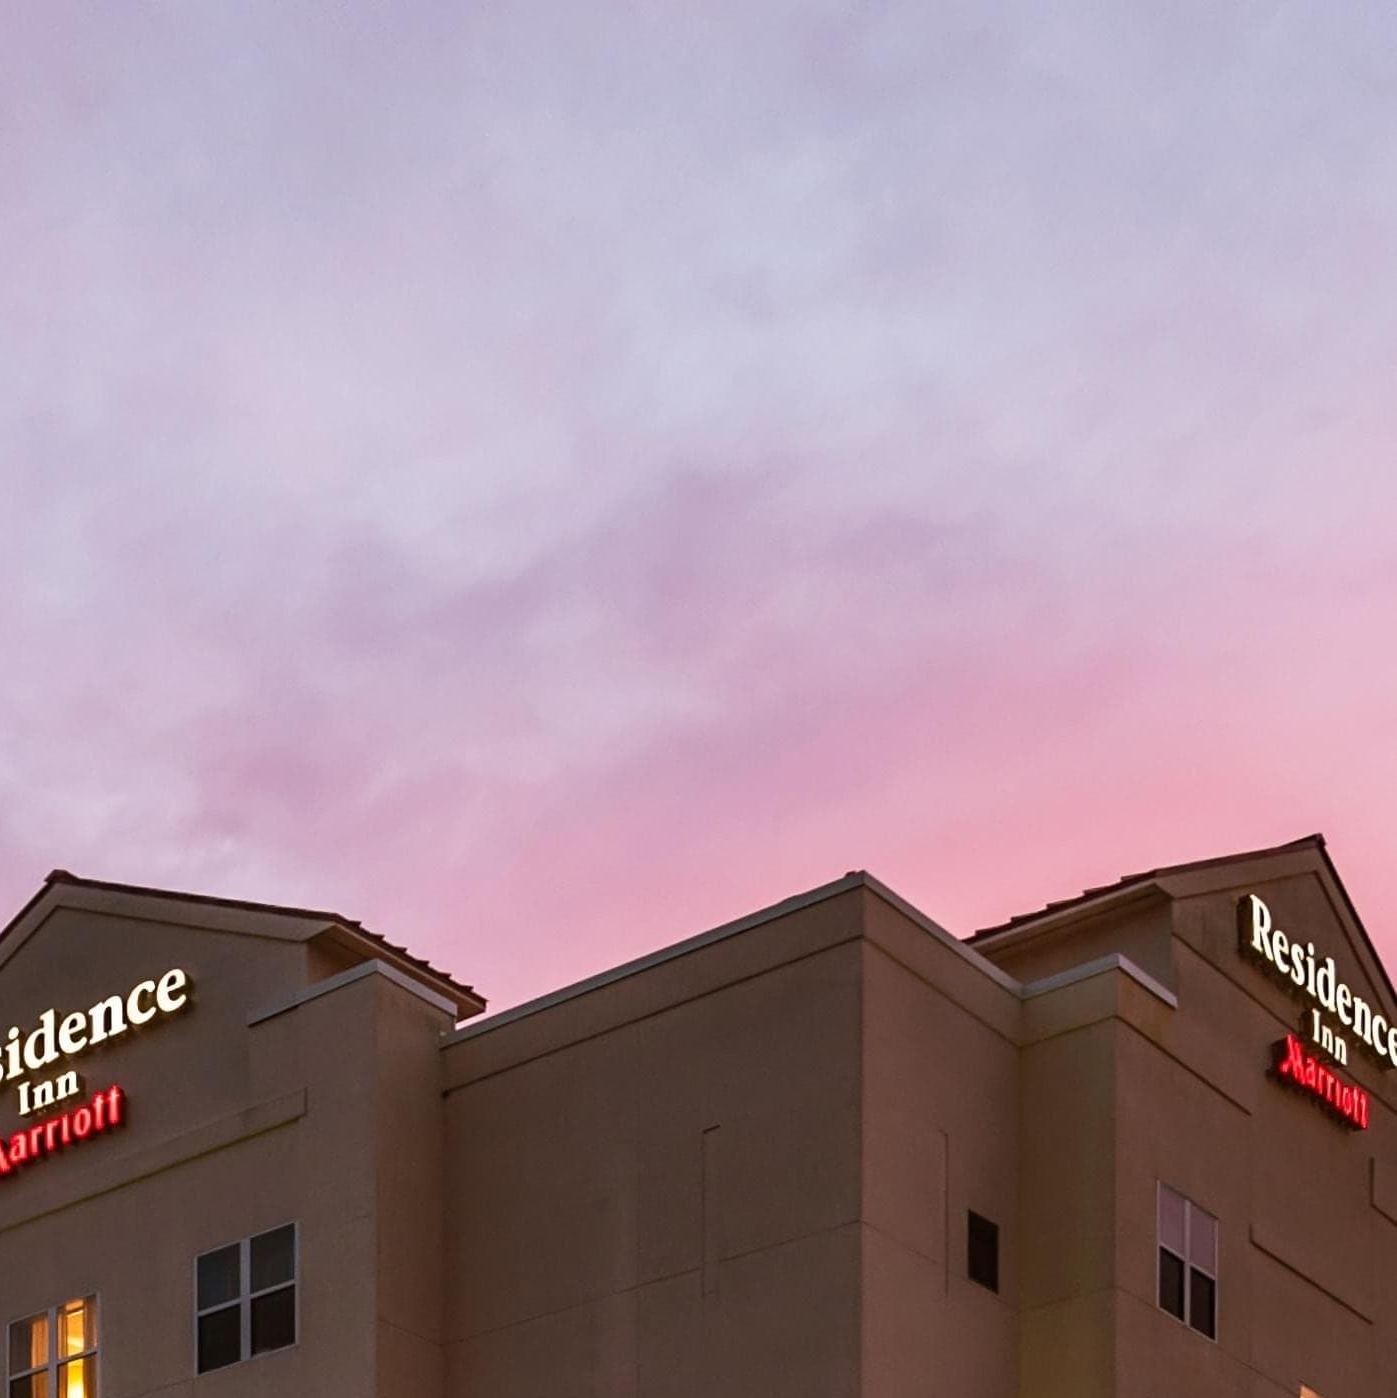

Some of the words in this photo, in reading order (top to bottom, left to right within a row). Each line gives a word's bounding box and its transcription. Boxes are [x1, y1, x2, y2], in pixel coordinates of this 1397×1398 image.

[1312, 1008, 1347, 1065] Inn
[18, 1070, 79, 1116] Inn
[1280, 1034, 1369, 1129] Marriott
